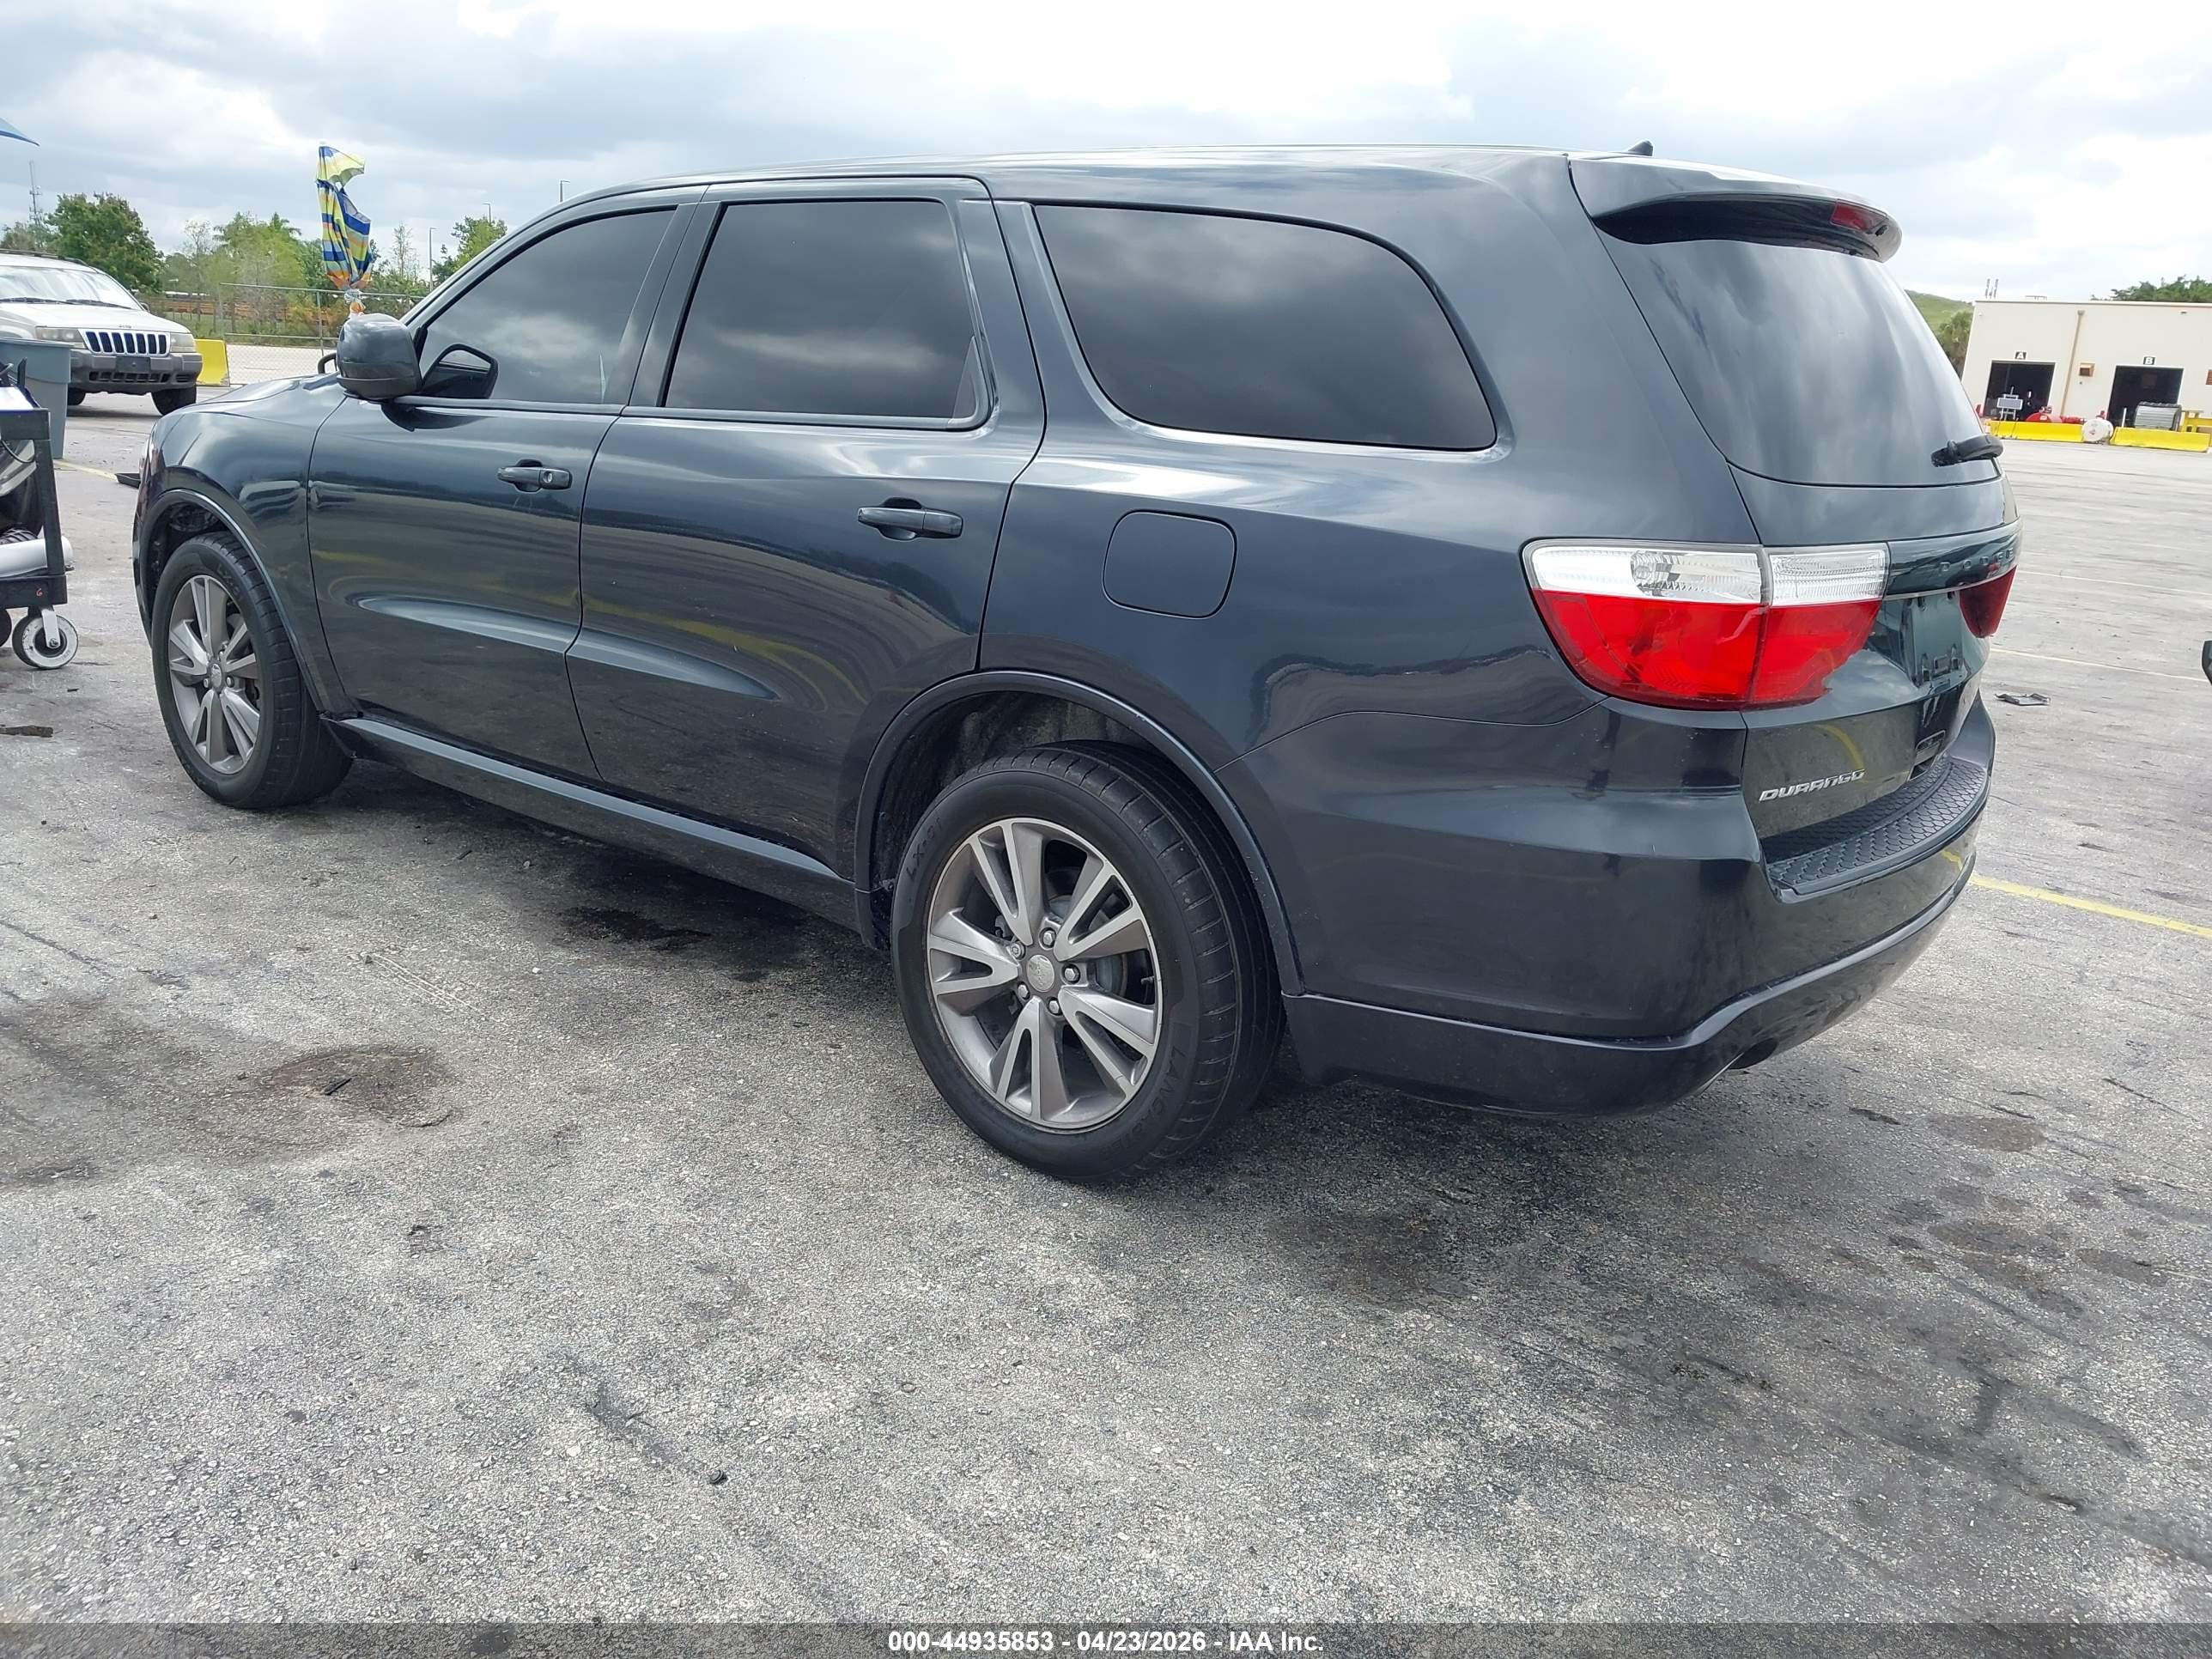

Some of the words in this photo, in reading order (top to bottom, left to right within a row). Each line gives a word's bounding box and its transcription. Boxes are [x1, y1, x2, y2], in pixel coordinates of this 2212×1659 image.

[2016, 351, 2025, 360] A
[2145, 356, 2154, 365] B
[1939, 547, 2014, 572] DODGE
[1759, 769, 1865, 802] DURANGO
